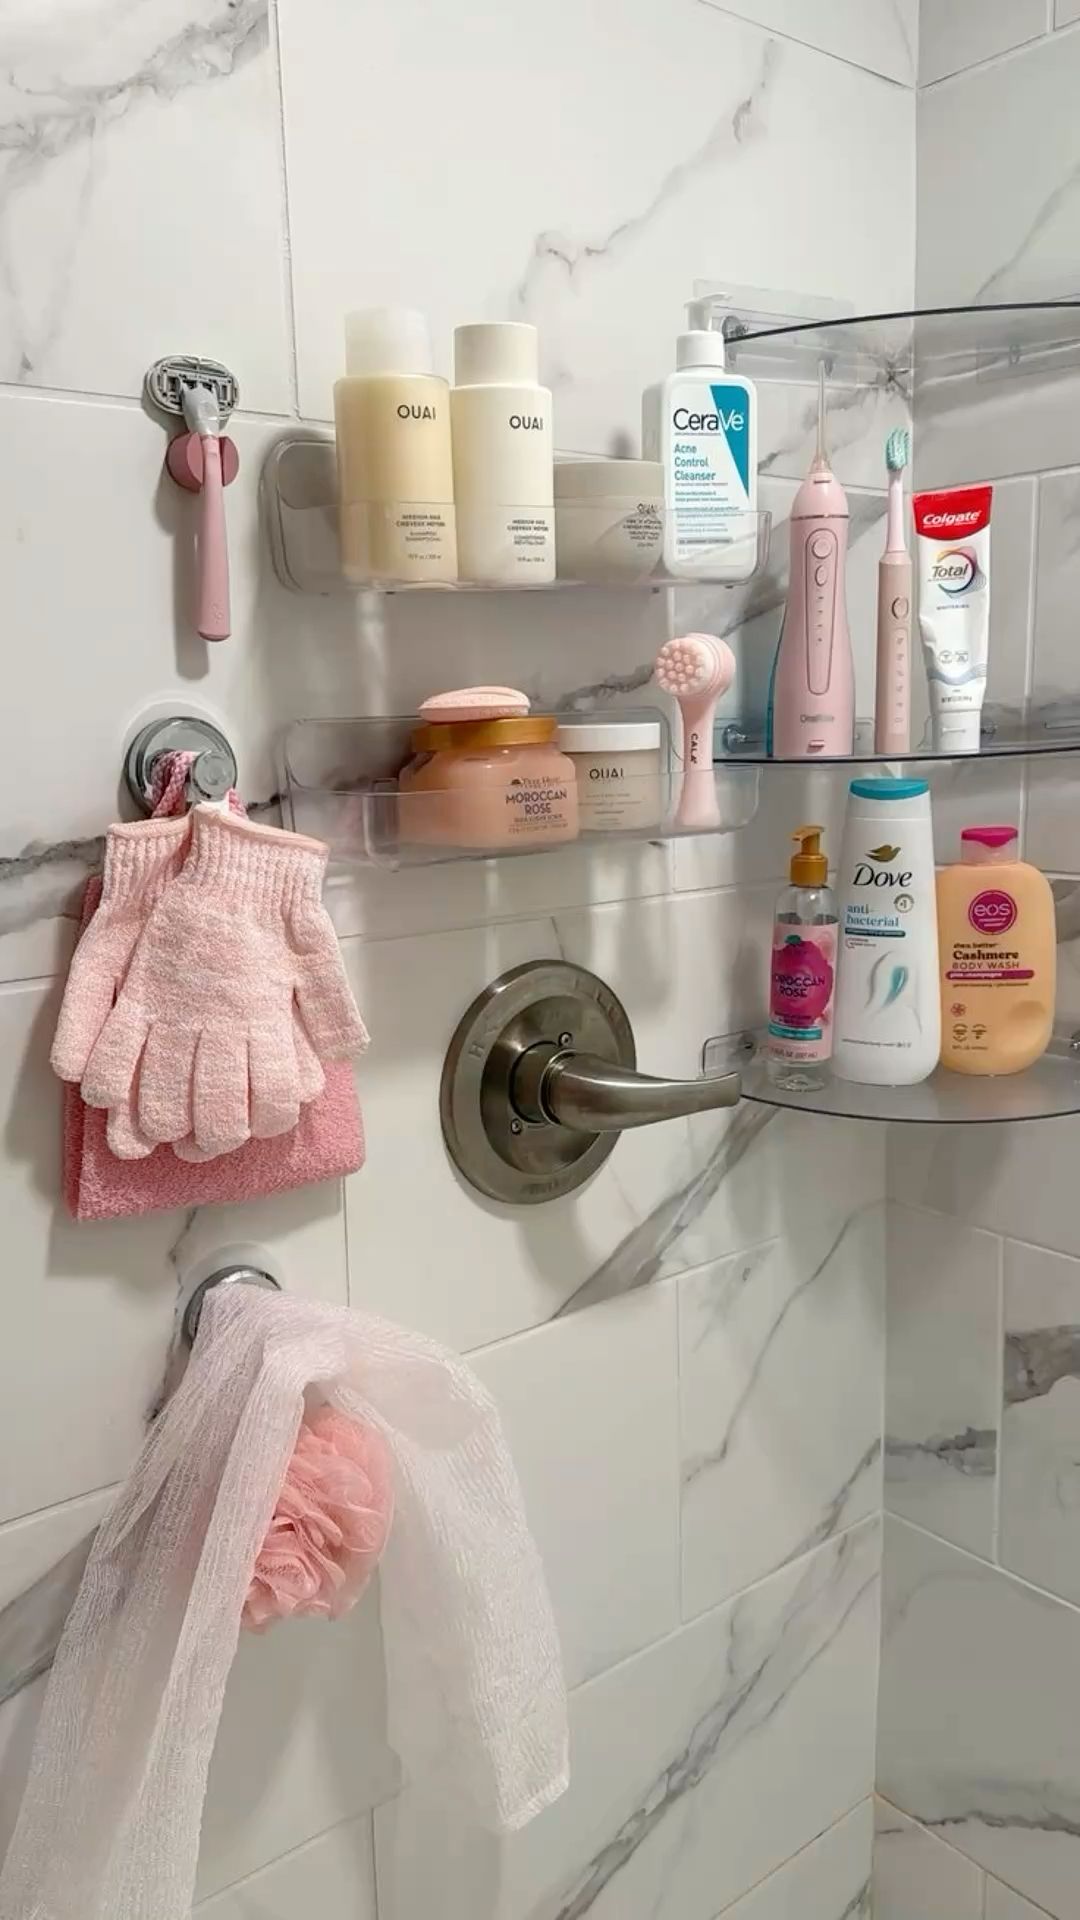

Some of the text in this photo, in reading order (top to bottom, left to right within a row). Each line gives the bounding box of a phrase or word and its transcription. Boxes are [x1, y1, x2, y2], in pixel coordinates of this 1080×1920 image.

[397, 404, 437, 420] OUAI
[673, 407, 745, 431] CeraVe
[509, 415, 544, 430] OUAI
[674, 444, 698, 454] Acne
[674, 456, 709, 467] Control
[674, 470, 717, 481] Cleanser
[922, 510, 981, 529] Colgate
[932, 563, 969, 577] Total
[690, 733, 698, 762] CALA
[589, 767, 624, 780] OUAI
[505, 789, 567, 804] MOROCCAN
[525, 803, 552, 814] ROSE
[853, 863, 912, 887] Dove
[974, 903, 1010, 917] eos
[846, 914, 899, 927] bacterial
[953, 950, 1019, 961] Cashmere
[952, 961, 1020, 969] BODY WASH
